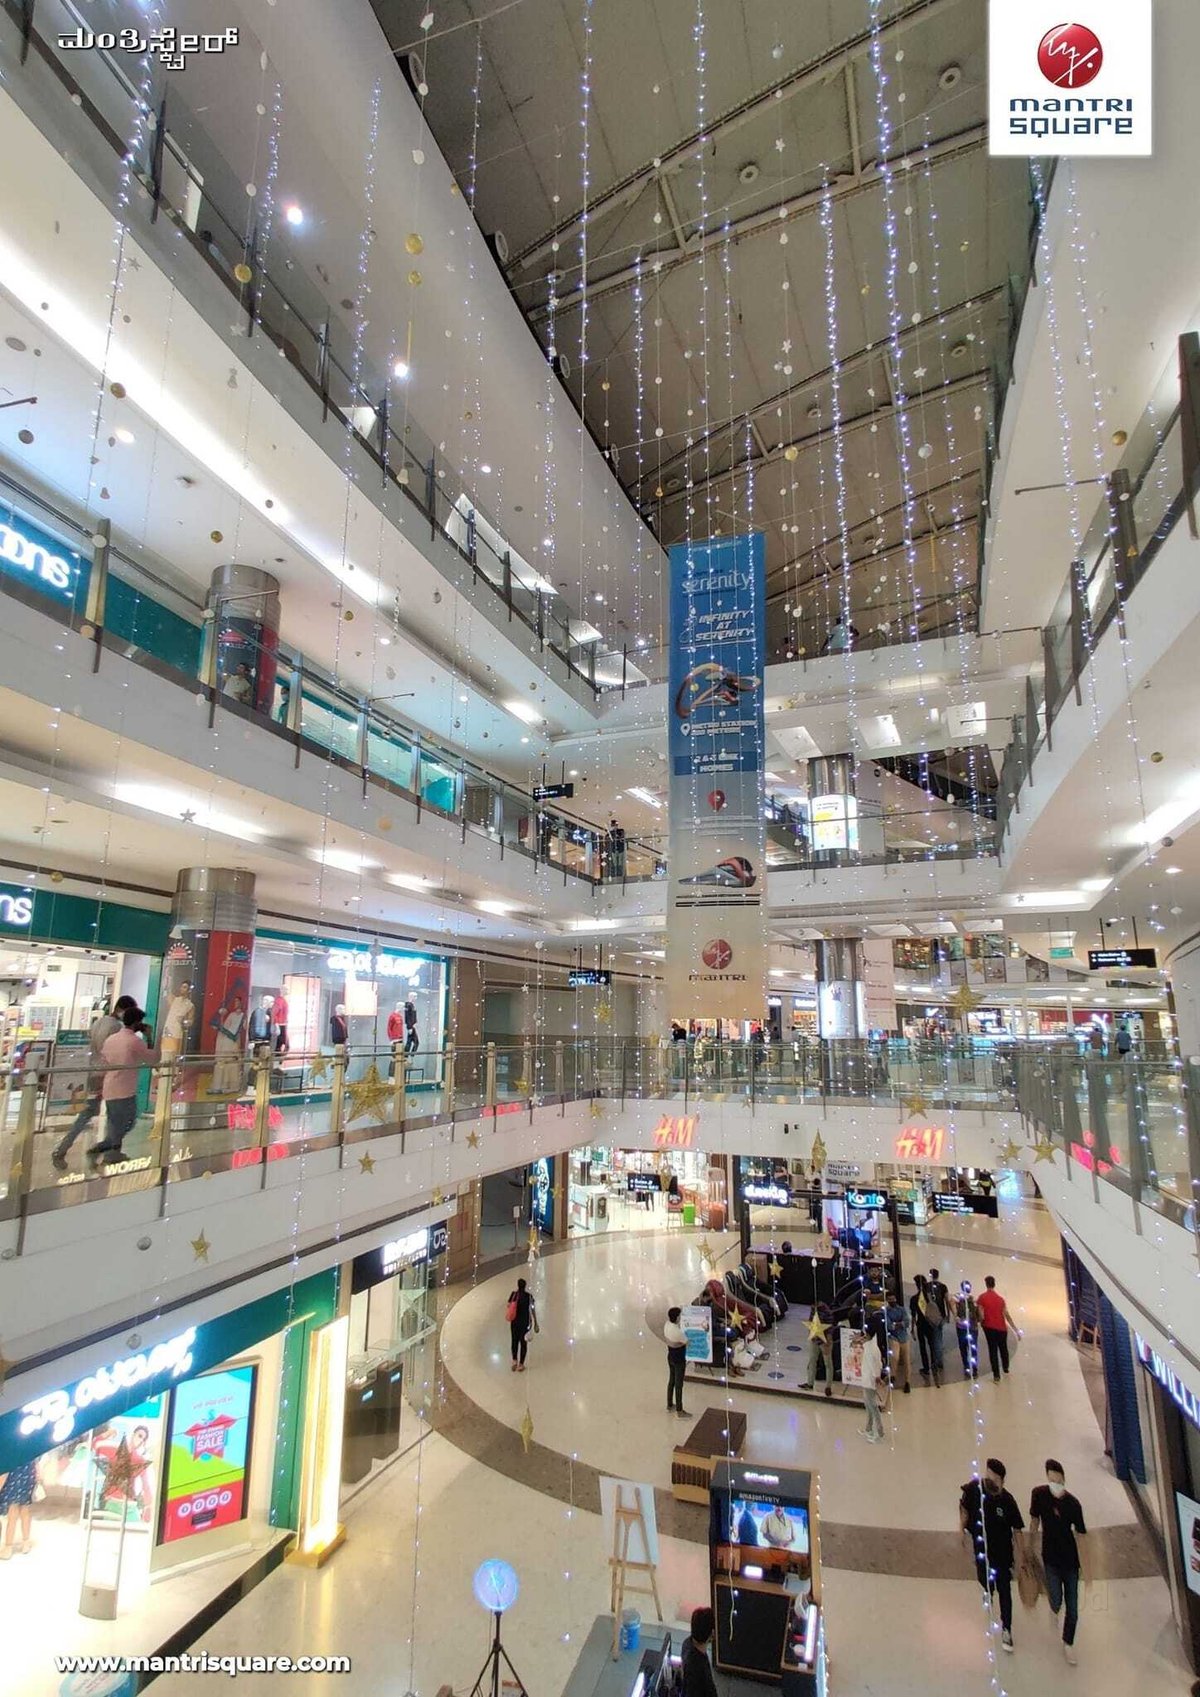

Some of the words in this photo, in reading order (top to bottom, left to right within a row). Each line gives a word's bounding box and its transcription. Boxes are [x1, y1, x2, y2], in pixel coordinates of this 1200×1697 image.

[681, 569, 751, 594] serenity
[698, 609, 750, 624] INFINITY
[715, 620, 732, 631] AT
[695, 628, 753, 641] SERENITY
[895, 1126, 946, 1160] H&M
[1151, 1348, 1200, 1430] WILLI
[197, 1435, 225, 1449] SALE
